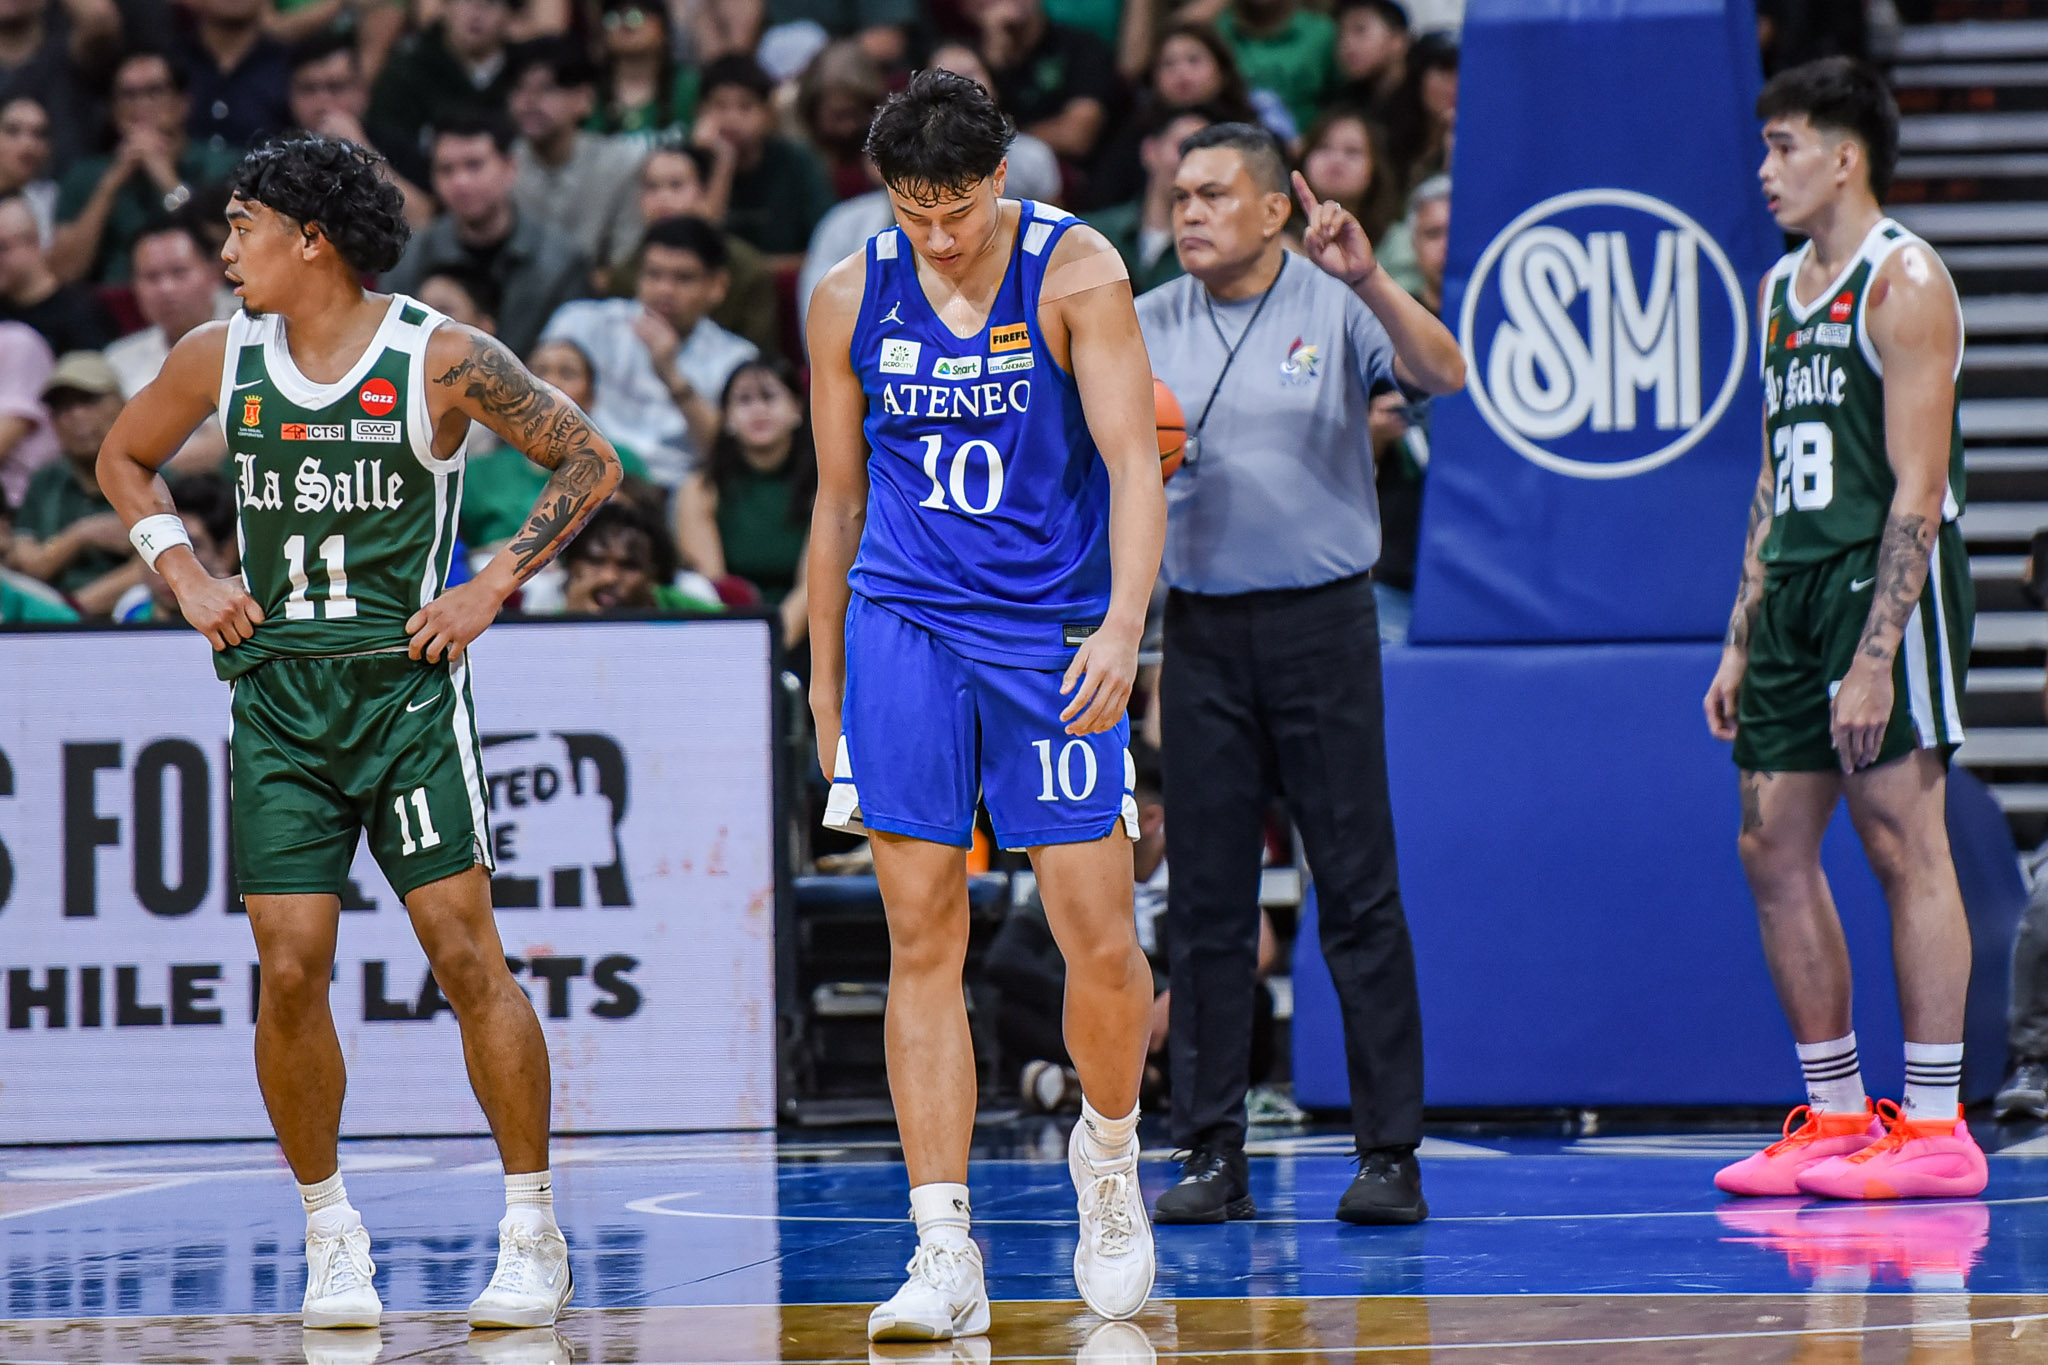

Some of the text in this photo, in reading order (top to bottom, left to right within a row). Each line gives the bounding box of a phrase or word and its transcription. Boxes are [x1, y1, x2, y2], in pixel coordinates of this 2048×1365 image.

[1488, 224, 1698, 440] SM
[360, 424, 392, 434] CWC
[362, 391, 393, 404] Gazz
[883, 379, 1031, 418] ATENEO
[307, 426, 343, 438] ICTSI
[234, 452, 405, 513] La Salle
[918, 433, 1005, 515] 10
[1773, 421, 1834, 517] 28
[283, 534, 358, 620] 11
[1031, 739, 1098, 802] 10
[394, 786, 441, 857] 11
[0, 963, 223, 1029] HILE
